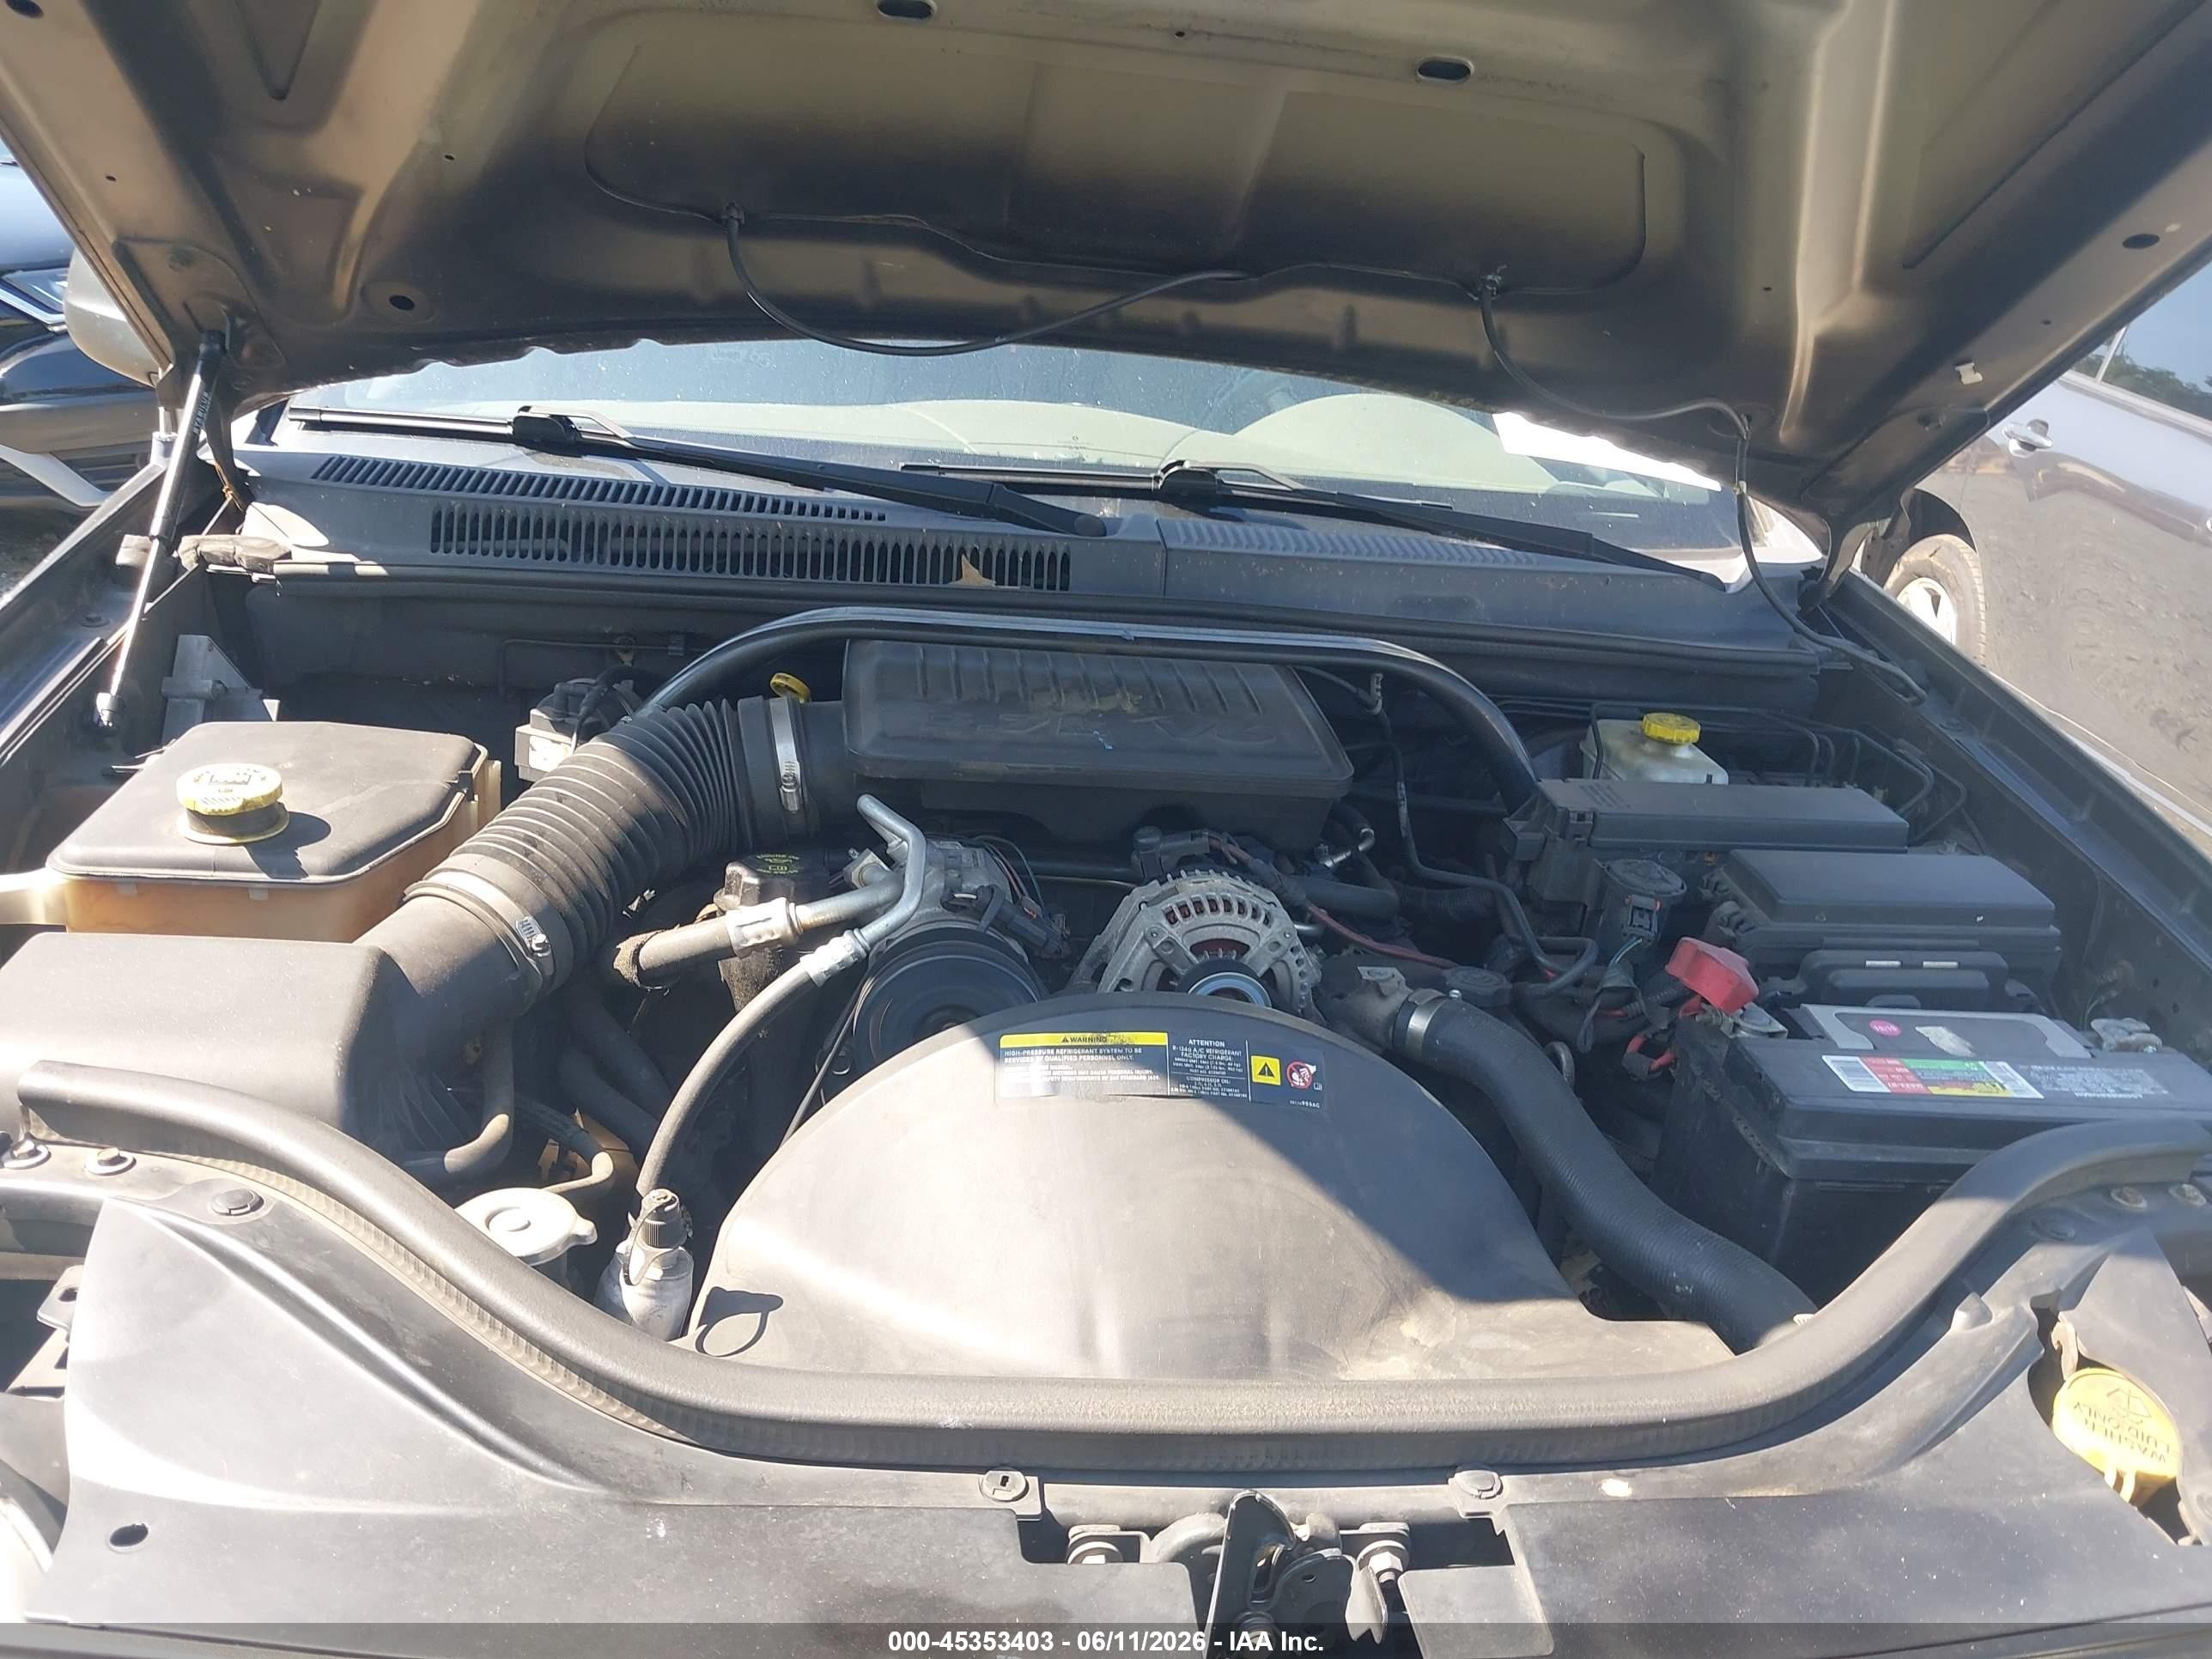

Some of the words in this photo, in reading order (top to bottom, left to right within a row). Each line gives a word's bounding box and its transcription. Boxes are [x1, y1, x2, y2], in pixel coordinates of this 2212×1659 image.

[1188, 1039, 1225, 1048] ATTENTION
[1181, 1051, 1207, 1060] FACTORY
[1206, 1048, 1242, 1057] REFRIGERANT
